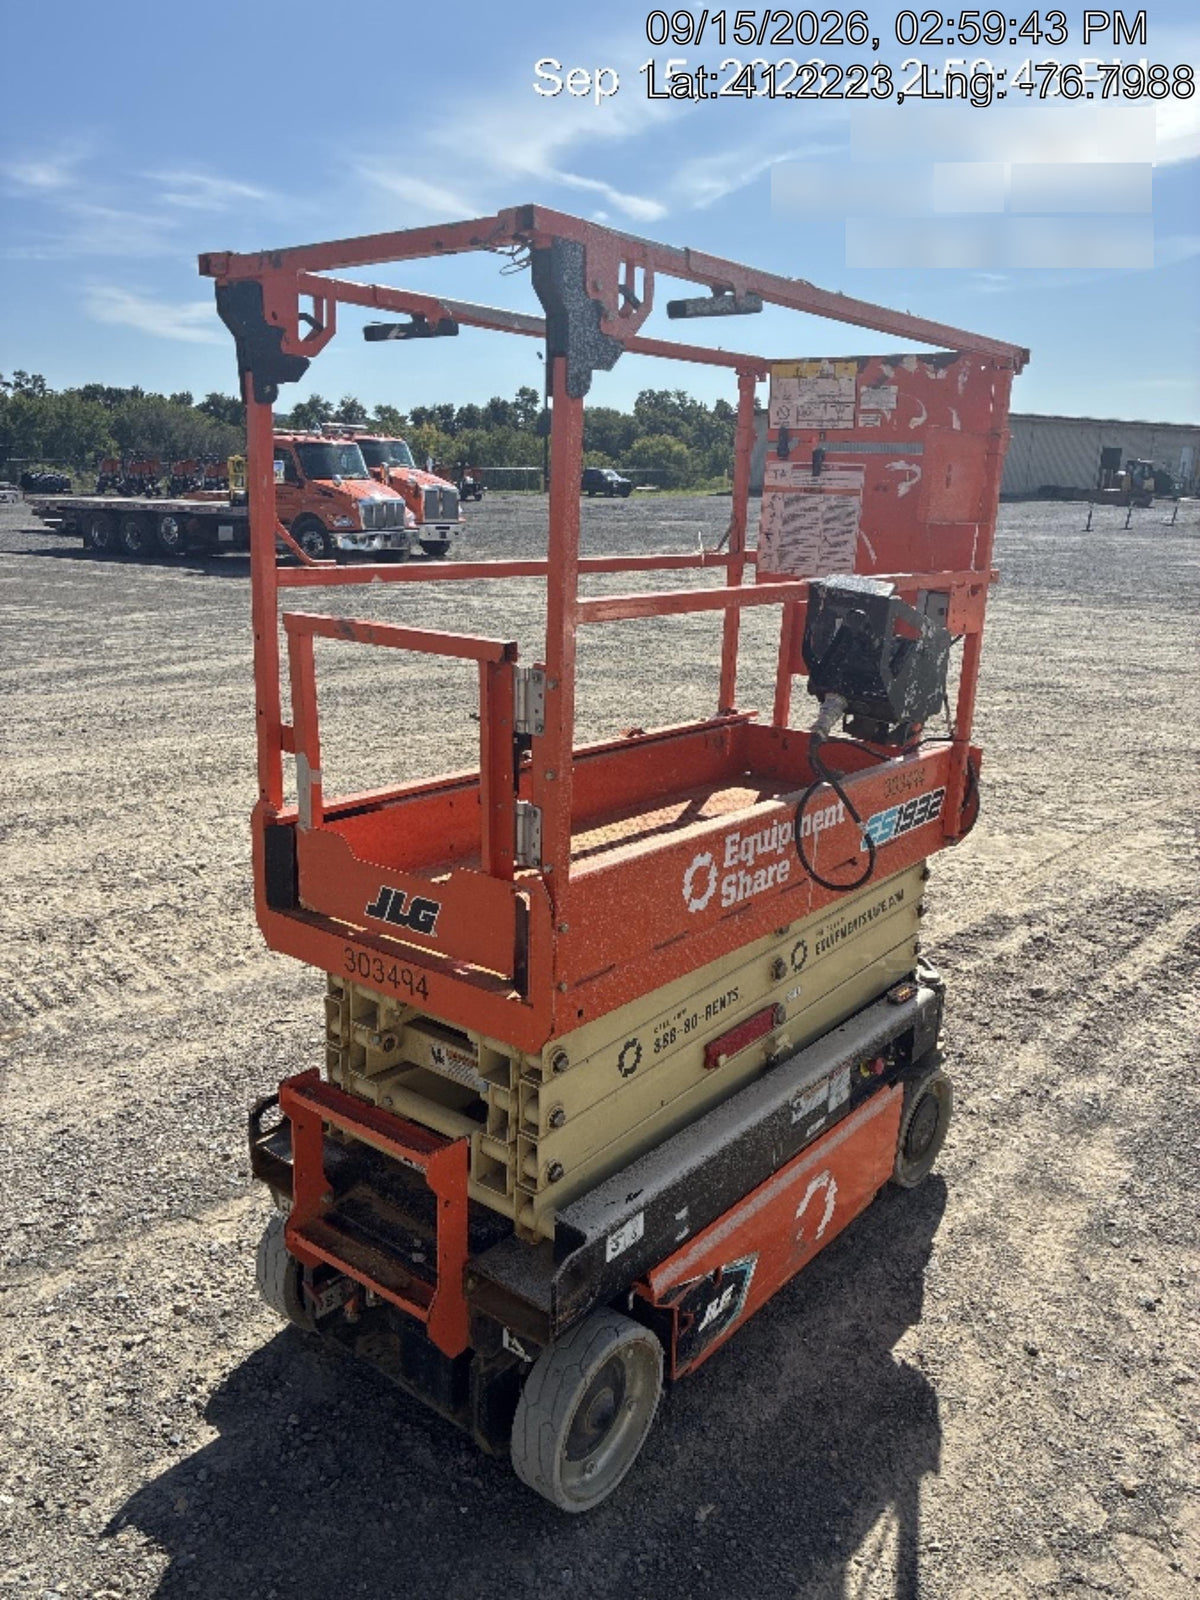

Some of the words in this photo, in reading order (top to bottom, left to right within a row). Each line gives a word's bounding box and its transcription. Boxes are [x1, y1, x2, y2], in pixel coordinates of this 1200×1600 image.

[723, 798, 845, 868] Equipment
[721, 858, 791, 908] Share
[364, 884, 442, 938] JLG
[343, 947, 430, 1001] 303494
